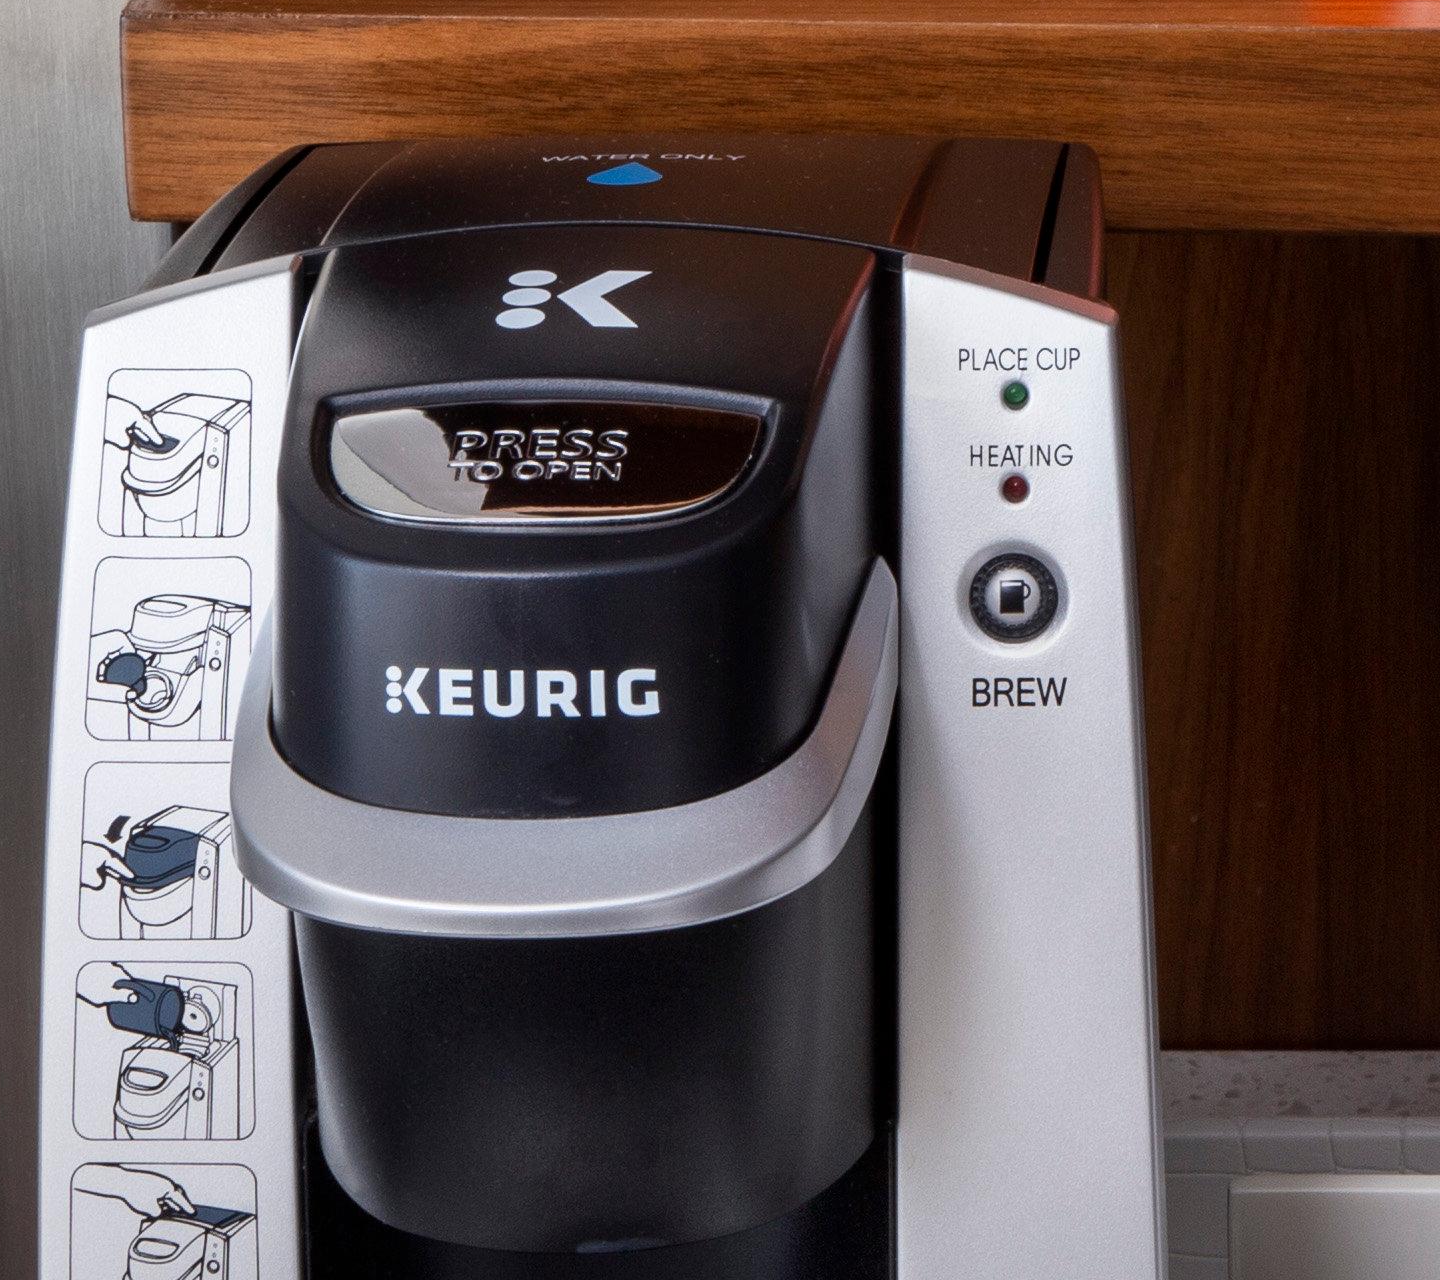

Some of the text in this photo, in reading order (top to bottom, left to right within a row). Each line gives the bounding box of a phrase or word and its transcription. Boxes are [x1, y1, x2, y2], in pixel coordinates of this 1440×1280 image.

[542, 153, 746, 162] WATER ONLY
[958, 347, 1081, 371] PLACE CUP
[449, 427, 629, 461] PRESS
[970, 443, 1074, 467] HEATING
[447, 459, 622, 483] TO OPEN
[385, 665, 661, 718] KEURIG
[972, 677, 1068, 707] BREW
